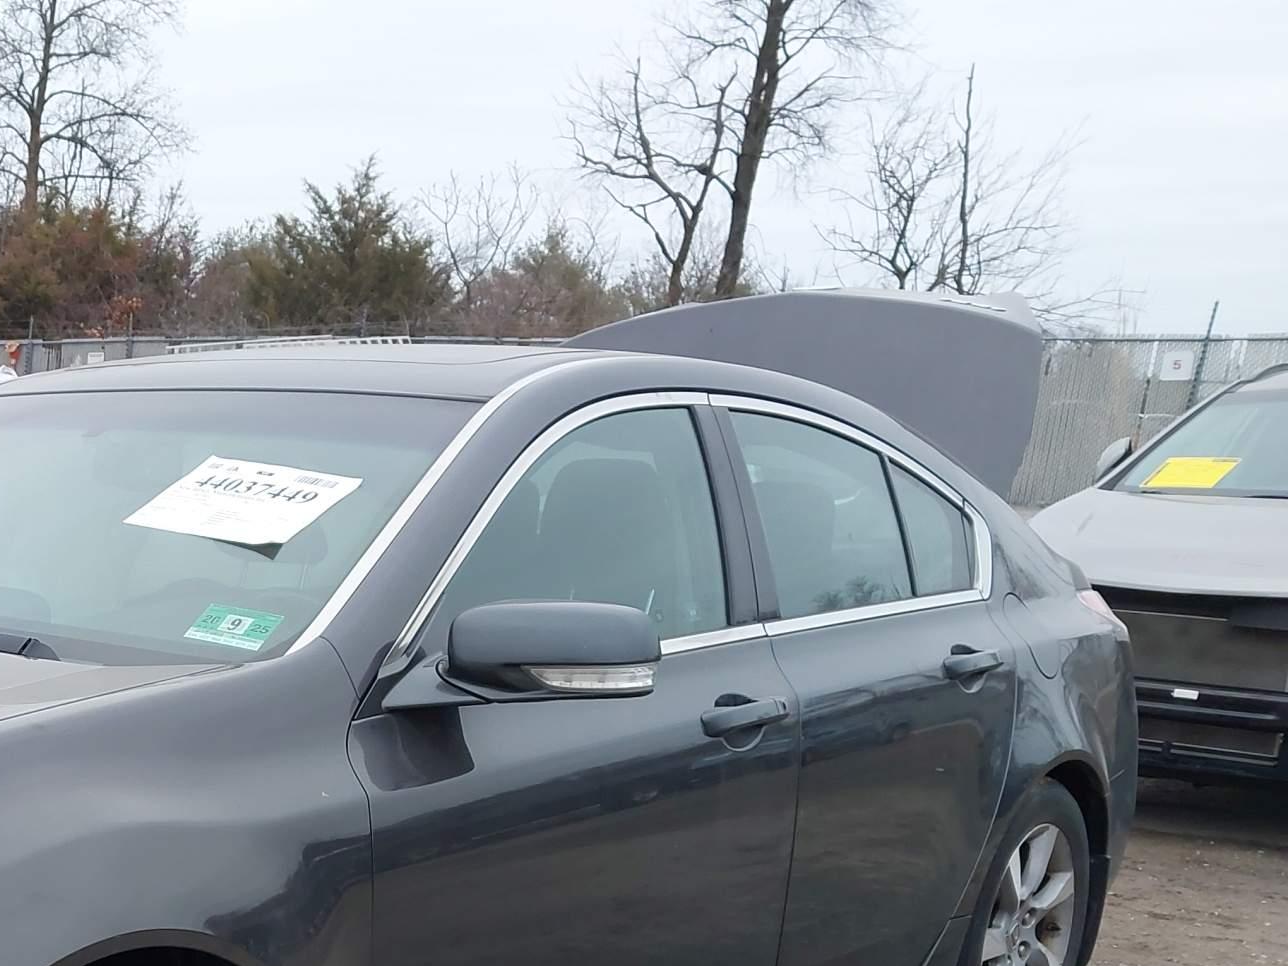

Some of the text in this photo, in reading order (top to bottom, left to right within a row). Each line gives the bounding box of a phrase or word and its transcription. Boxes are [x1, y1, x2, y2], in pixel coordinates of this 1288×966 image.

[1172, 359, 1183, 370] 5
[194, 475, 319, 504] 44037449
[227, 617, 242, 631] 9
[250, 623, 271, 634] 25
